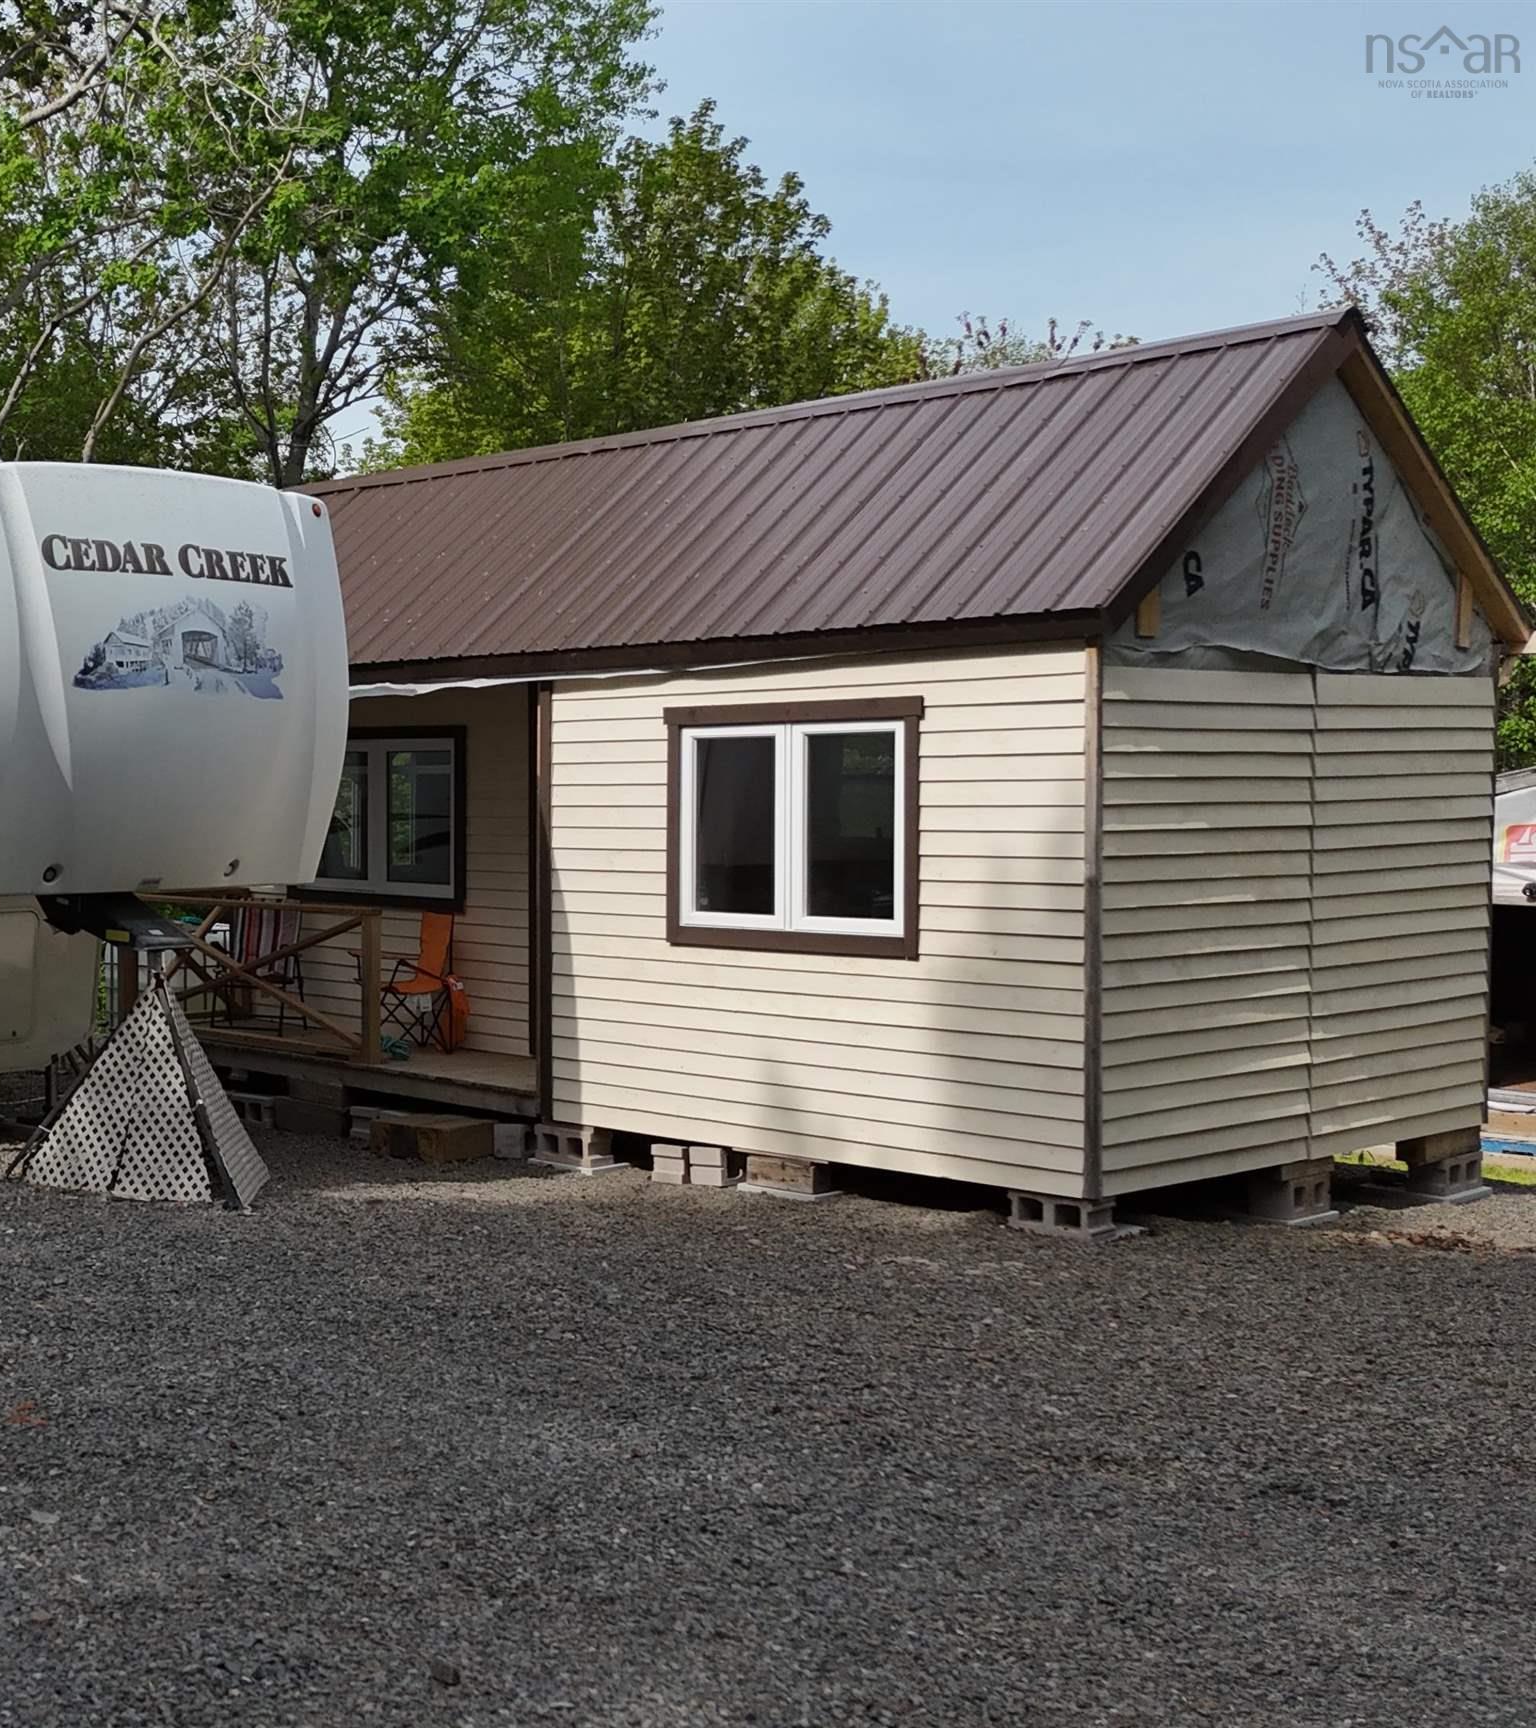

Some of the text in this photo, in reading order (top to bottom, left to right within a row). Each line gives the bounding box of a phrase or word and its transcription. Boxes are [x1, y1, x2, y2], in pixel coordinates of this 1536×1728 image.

[41, 534, 293, 588] CEDAR CREEK
[1260, 510, 1283, 610] SUPPLIES
